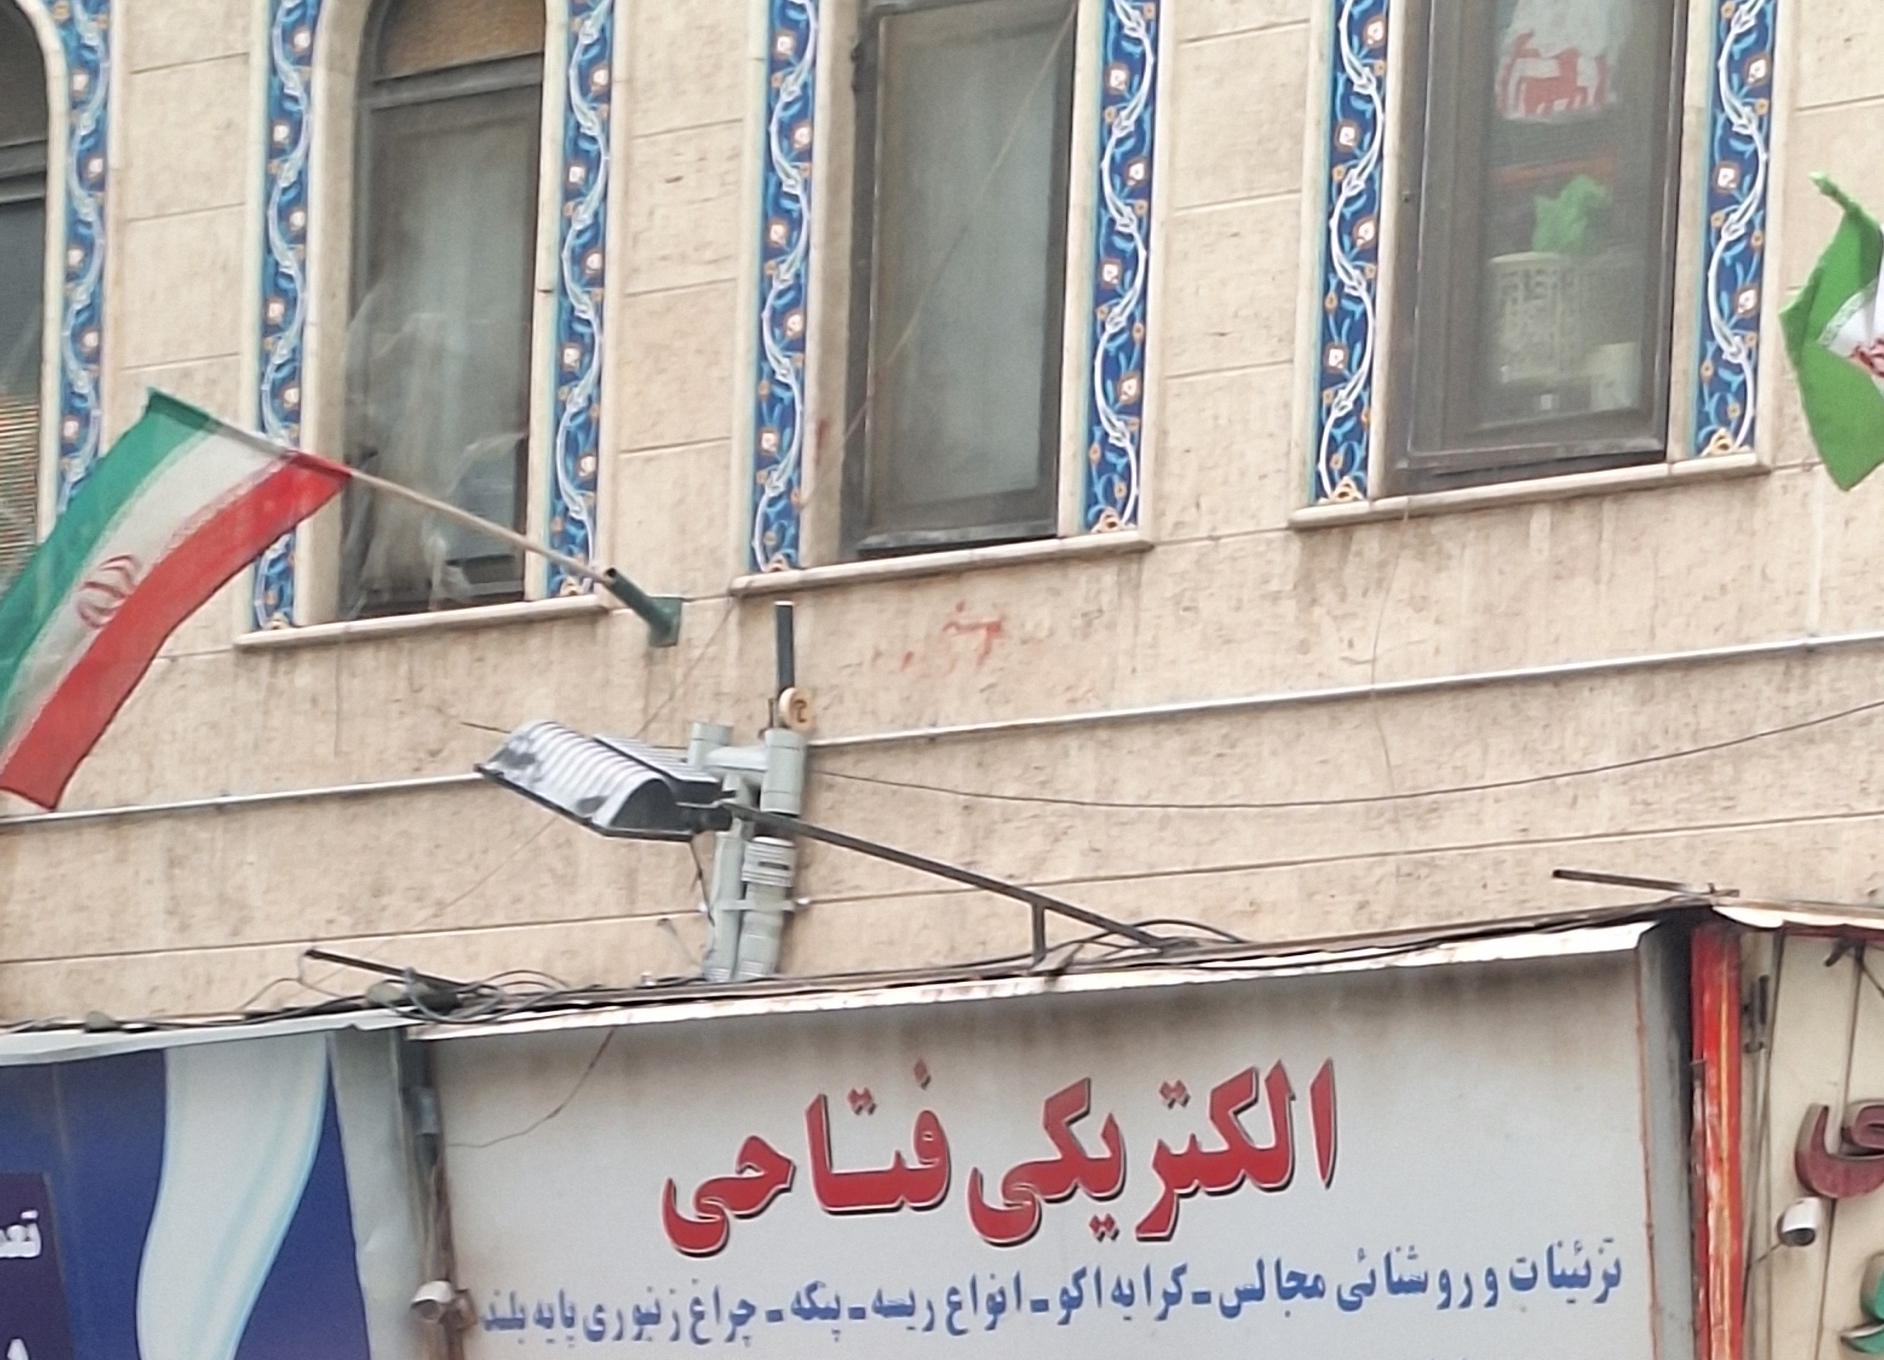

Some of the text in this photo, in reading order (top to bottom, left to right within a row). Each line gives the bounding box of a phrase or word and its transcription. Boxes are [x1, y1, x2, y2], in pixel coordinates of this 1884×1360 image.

[662, 1058, 1338, 1257] الکتریکی فتاحی
[945, 1269, 1022, 1336] انواع
[1110, 1263, 1188, 1321] کرایه
[1219, 1257, 1326, 1319] مجالس
[1336, 1244, 1474, 1313] روشنائی
[1508, 1237, 1622, 1304] تزئینات
[688, 1277, 756, 1347] چراغ
[870, 1287, 935, 1333] ریسه
